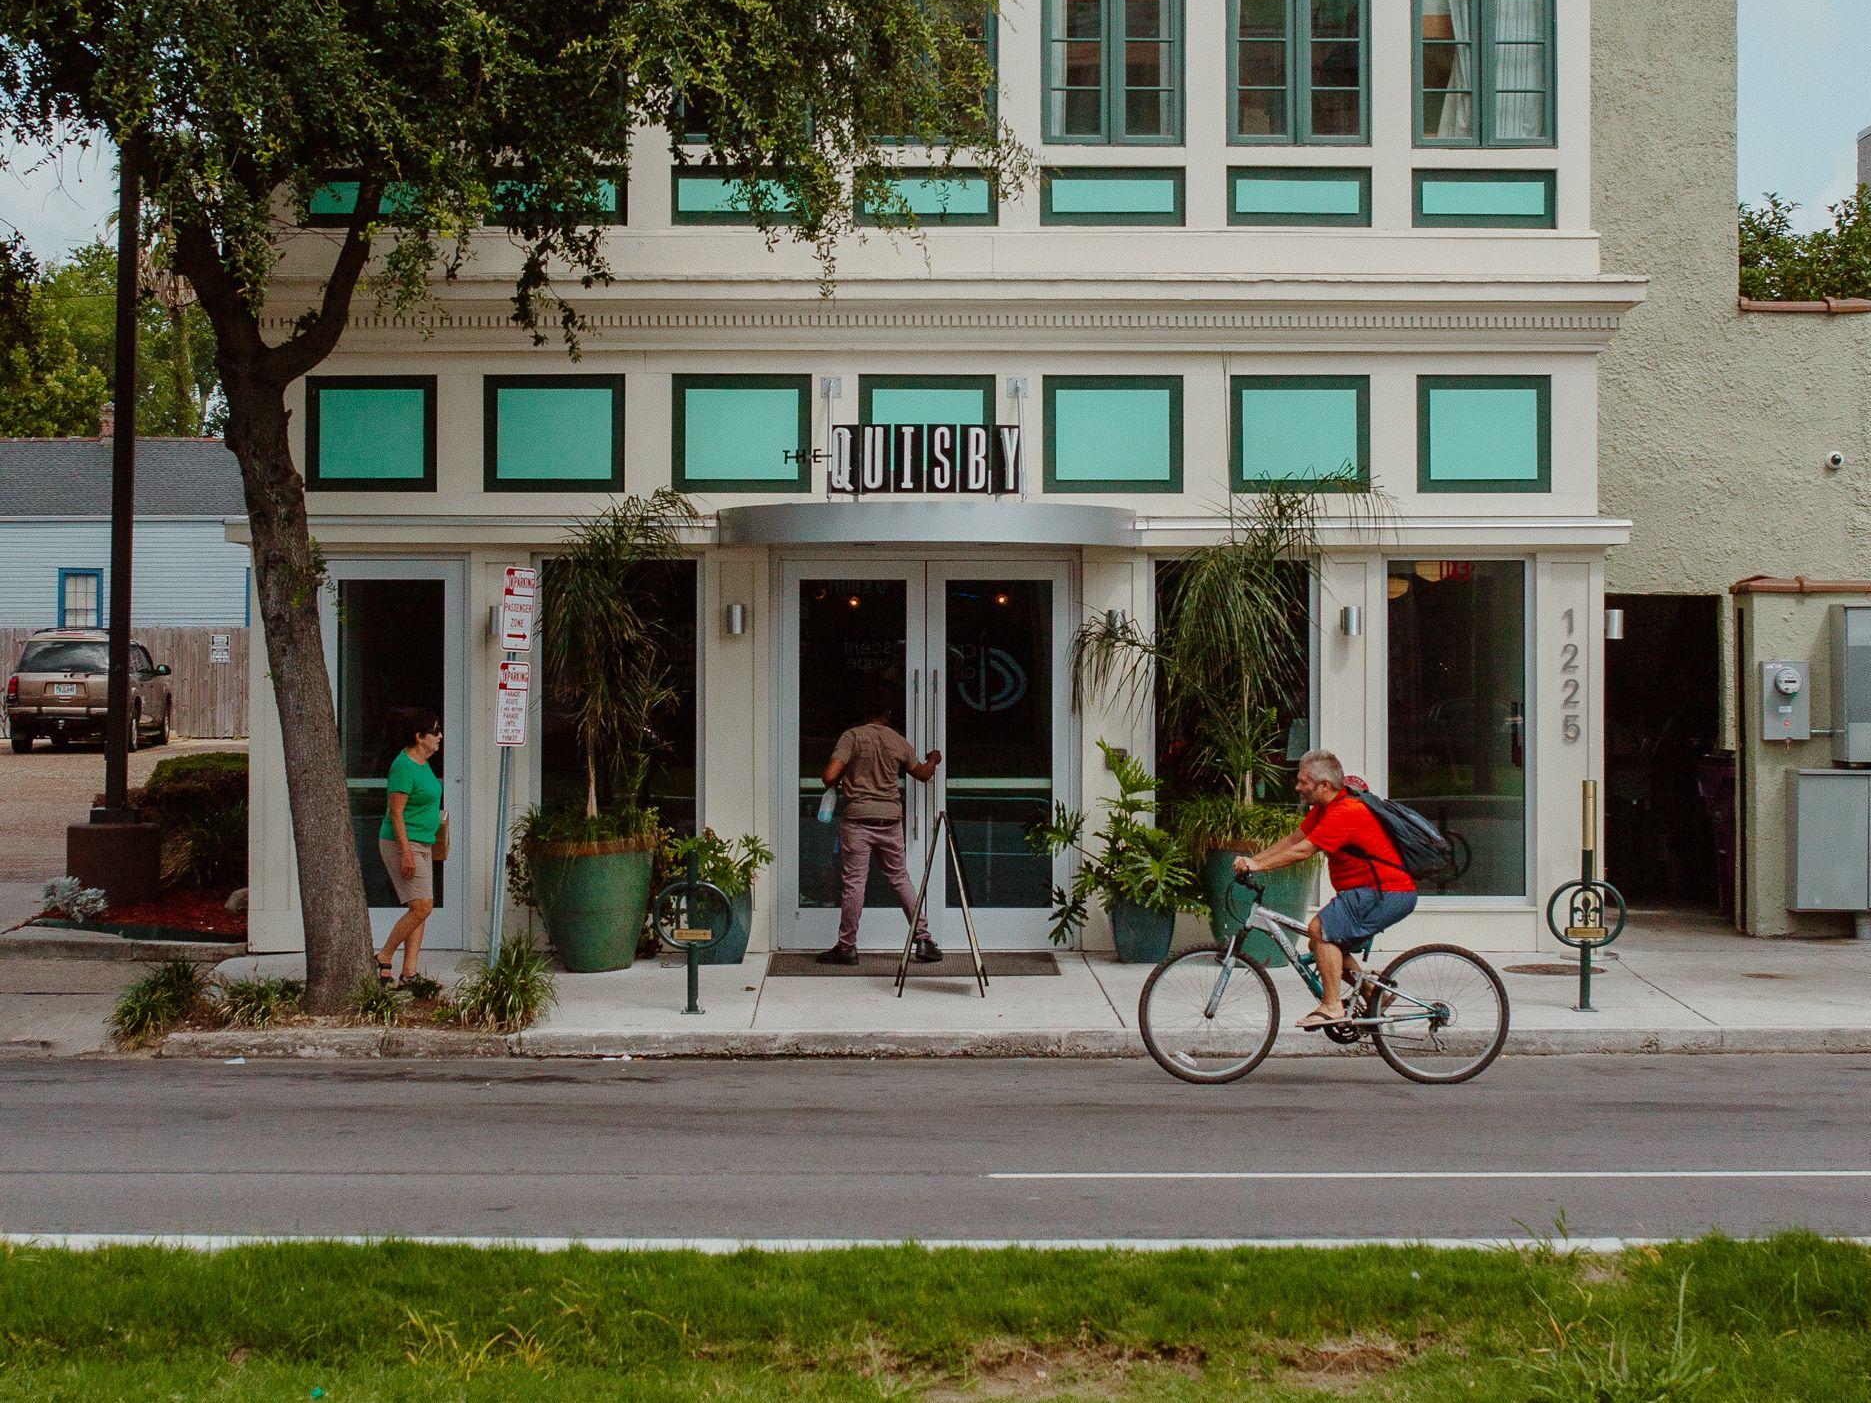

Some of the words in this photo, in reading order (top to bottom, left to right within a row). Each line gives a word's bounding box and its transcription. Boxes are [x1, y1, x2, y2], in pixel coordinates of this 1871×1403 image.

[782, 448, 821, 464] THE
[831, 426, 1019, 490] QUISBY
[514, 576, 535, 589] PARKING
[505, 602, 533, 613] PASSENGER
[511, 618, 524, 627] ZONE
[1560, 607, 1581, 744] 1225
